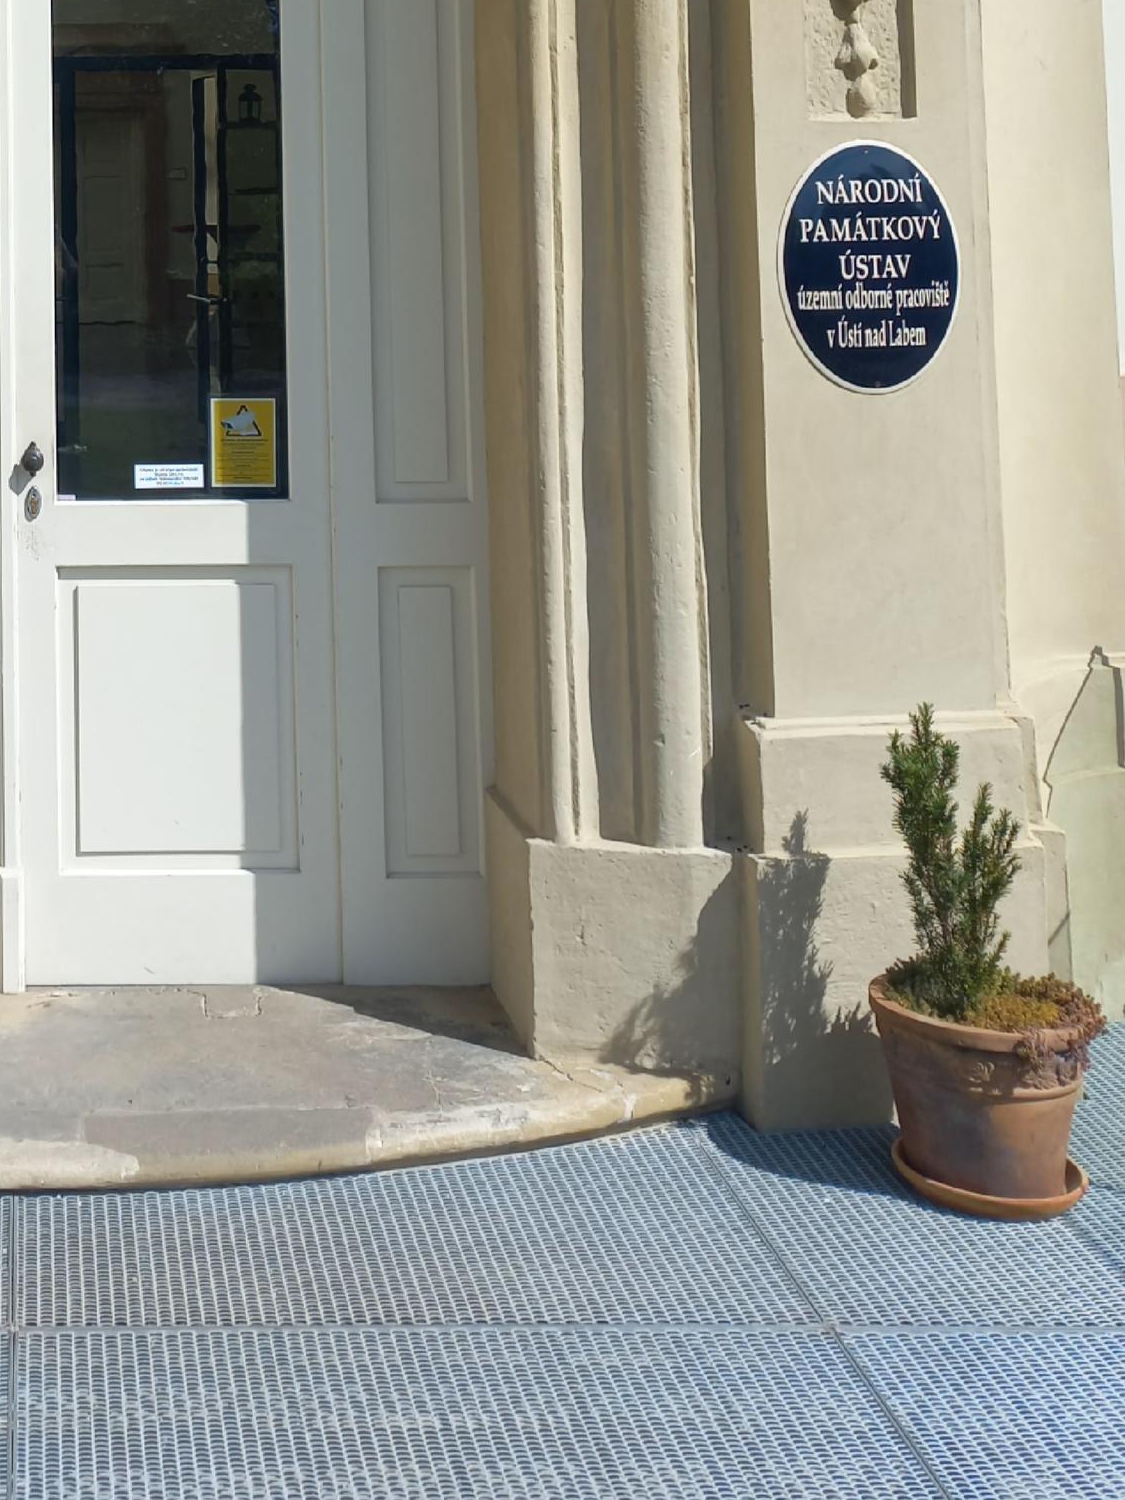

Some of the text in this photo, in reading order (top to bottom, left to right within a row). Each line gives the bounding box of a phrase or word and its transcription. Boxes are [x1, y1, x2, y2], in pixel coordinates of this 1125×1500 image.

[815, 174, 923, 205] NÁRODNÍ
[799, 209, 941, 243] PAMÁTKOVÝ
[839, 249, 911, 280] ÚSTAV
[797, 280, 950, 316] územní odborné pracoviště
[826, 315, 926, 349] v Ústí nad Labem
